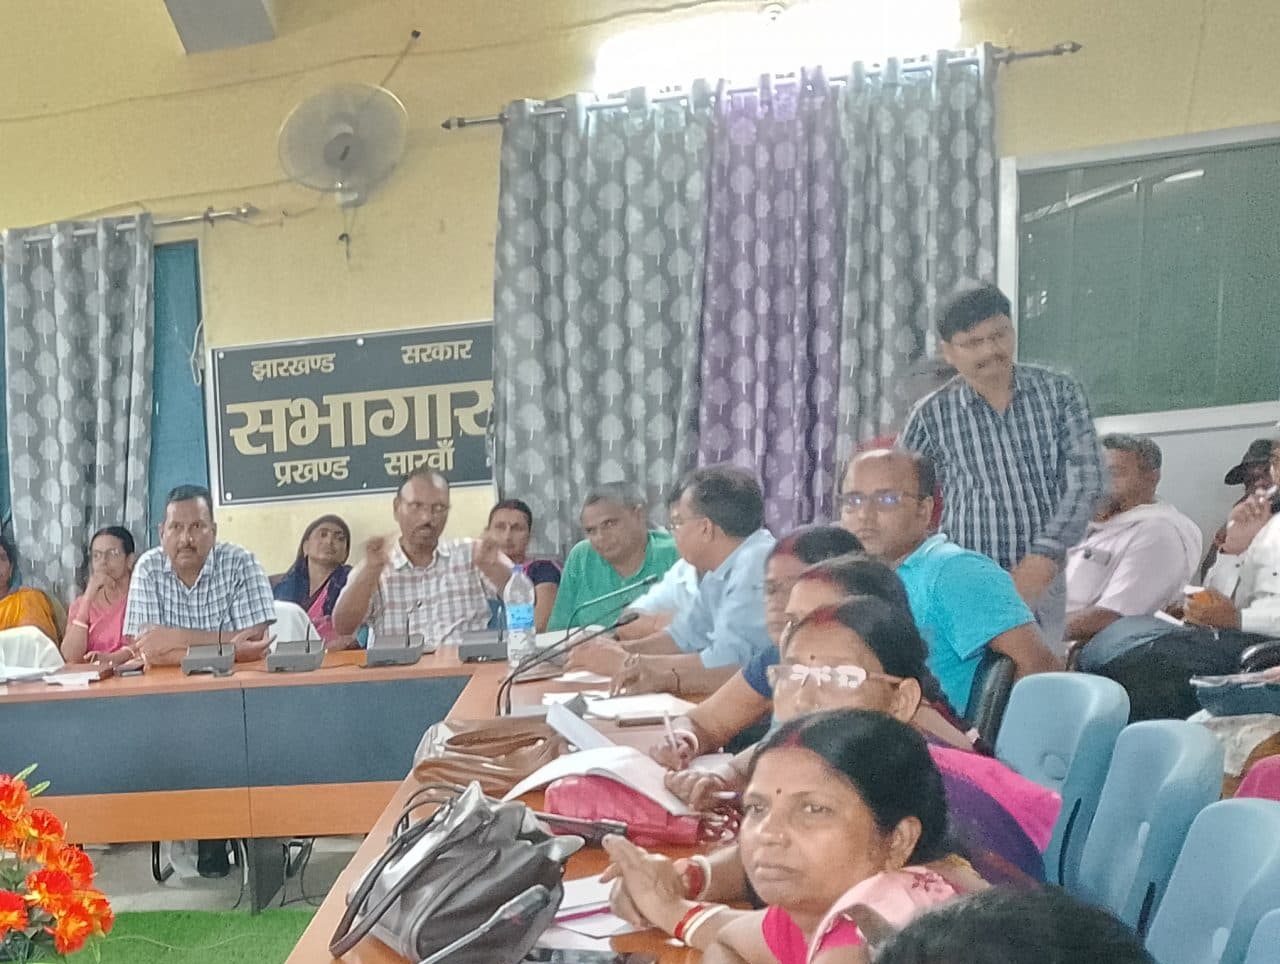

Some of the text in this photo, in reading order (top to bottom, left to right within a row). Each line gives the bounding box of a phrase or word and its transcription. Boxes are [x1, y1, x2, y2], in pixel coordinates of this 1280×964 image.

[251, 340, 473, 381] झारखण्ड सरकार
[226, 380, 494, 455] सभागार
[273, 456, 350, 487] प्रखण्ड
